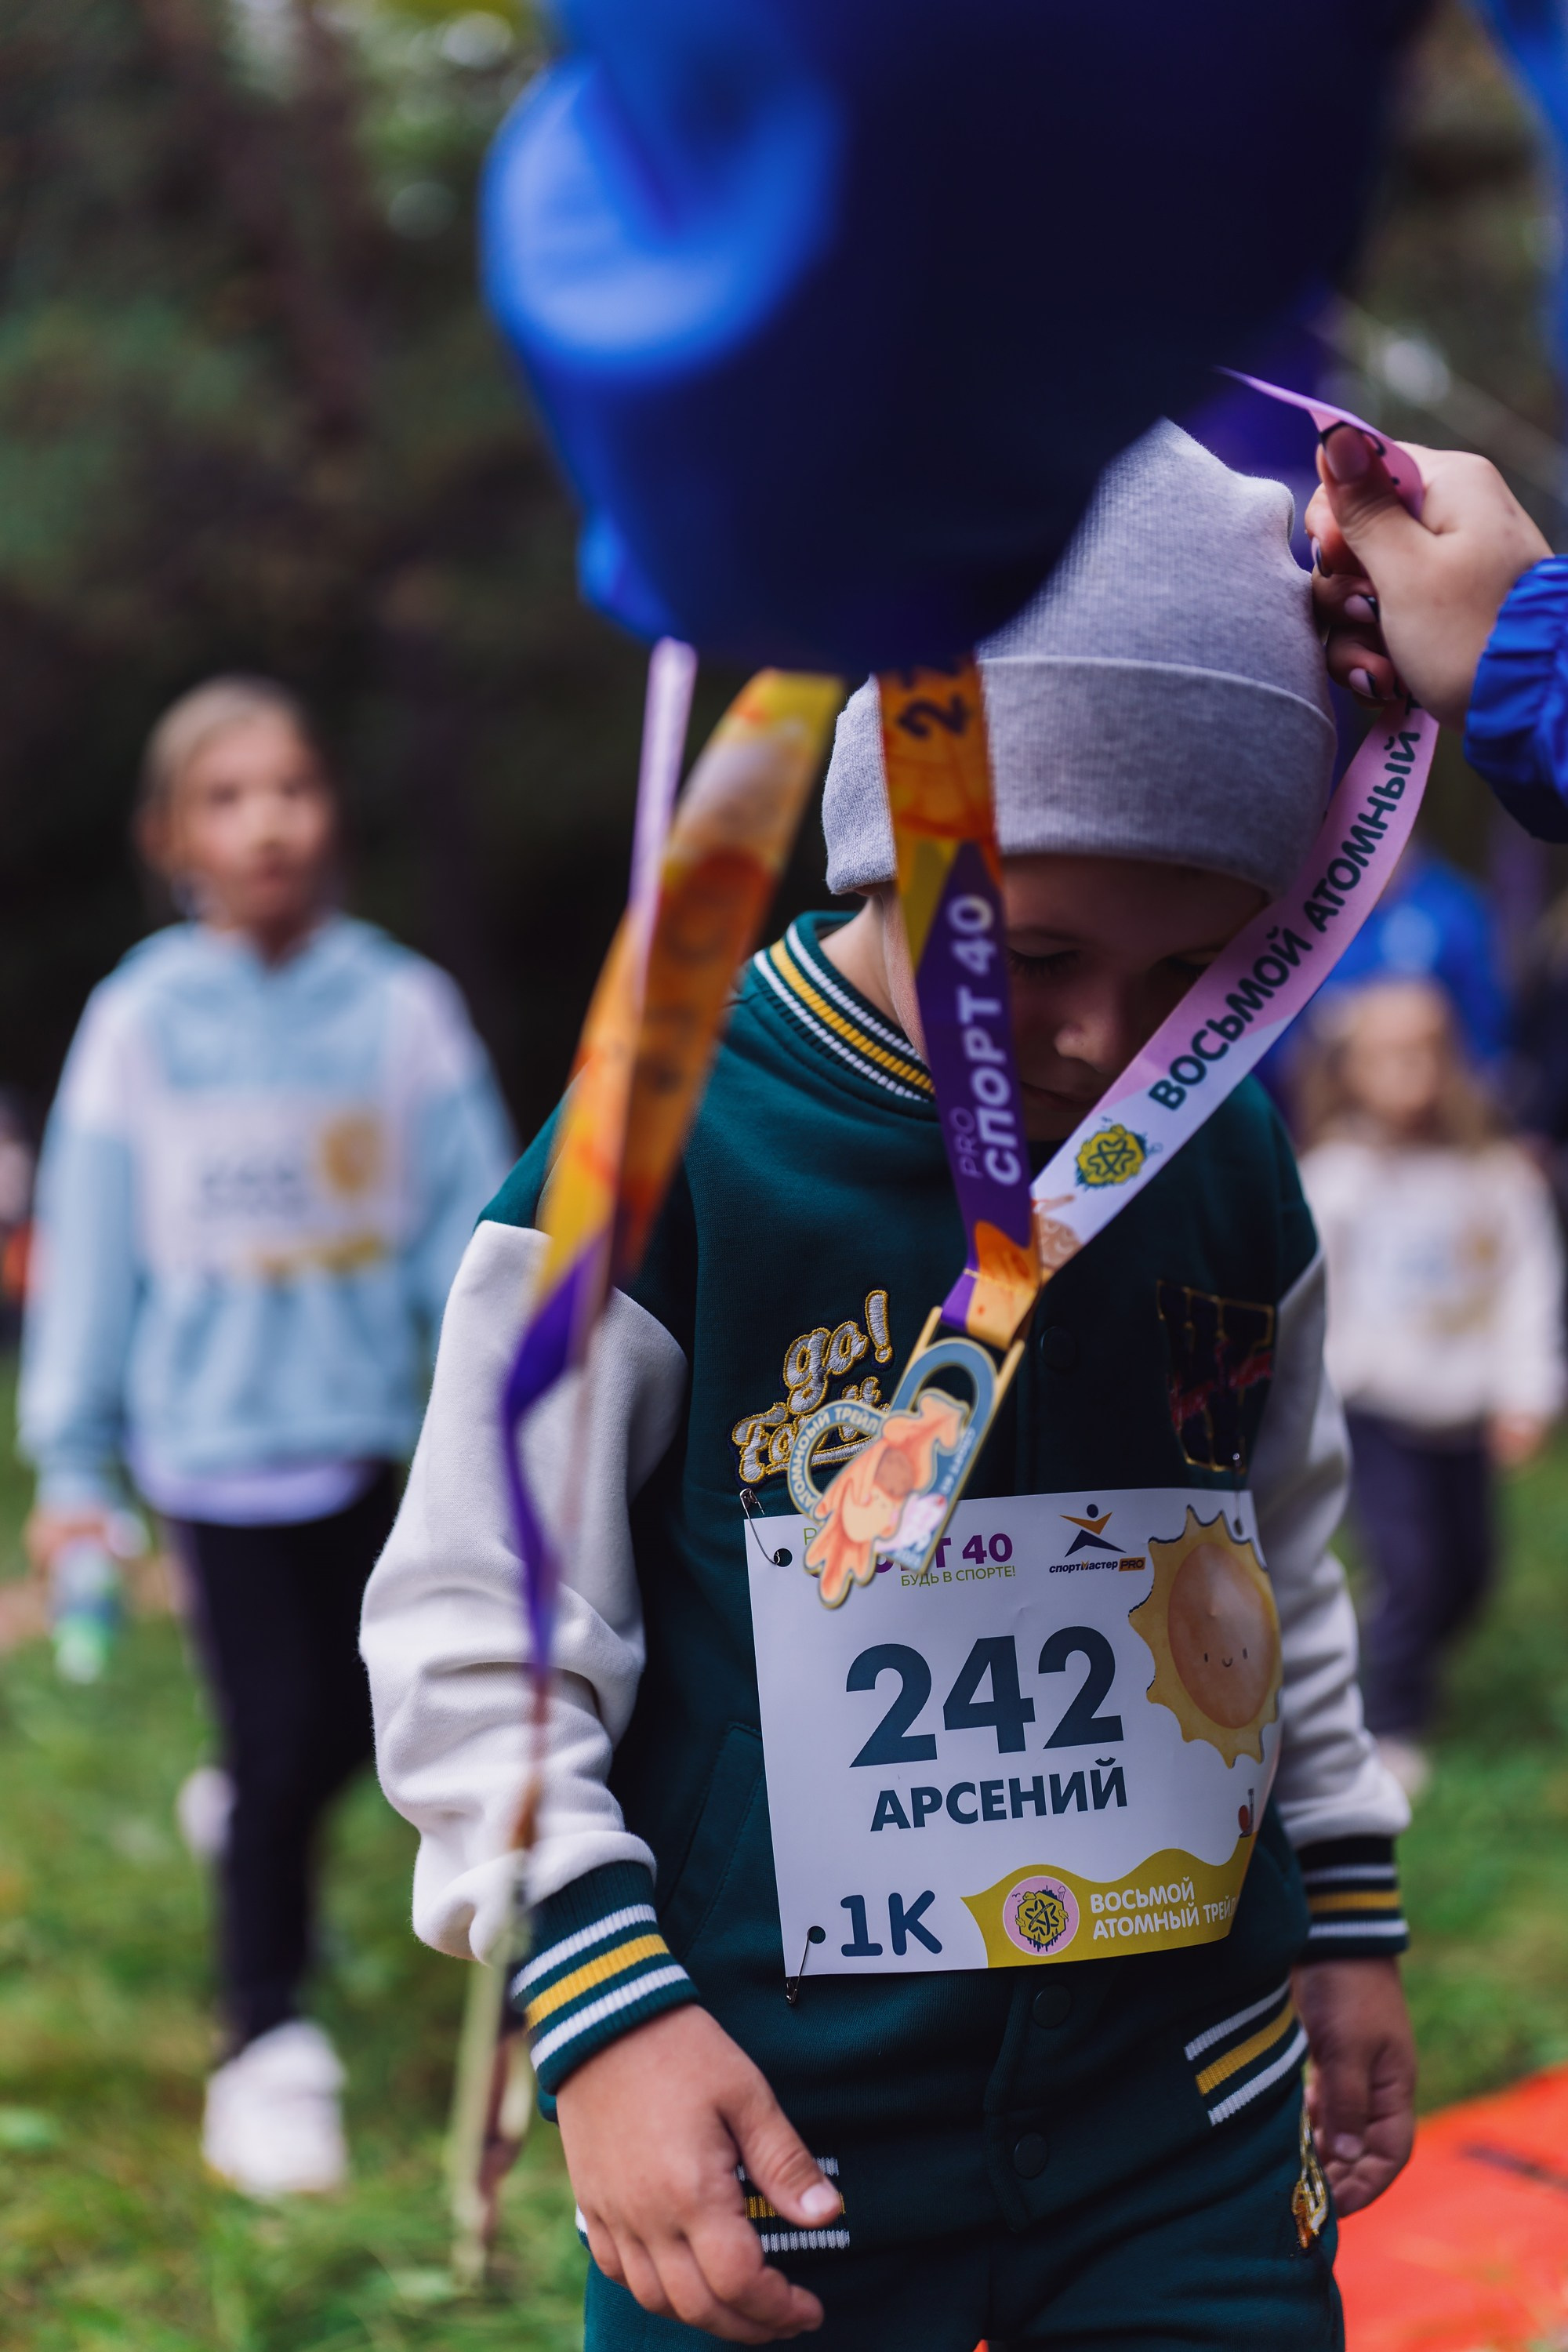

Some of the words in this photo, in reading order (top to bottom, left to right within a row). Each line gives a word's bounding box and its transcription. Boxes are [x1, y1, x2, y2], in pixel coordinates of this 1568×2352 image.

[947, 895, 996, 977] 40
[1148, 927, 1312, 1110] ВОСЬМОЙ
[1303, 731, 1421, 933] АТОМНЫЙ
[956, 985, 1022, 1187] СПОРТ
[782, 1289, 893, 1416] go!
[901, 1571, 940, 1588] БУДЬ
[942, 1570, 953, 1584] В
[955, 1565, 1017, 1582] СПОРТЕ!
[961, 1533, 1014, 1566] 40
[1120, 1559, 1145, 1570] PRO
[846, 1625, 1124, 1769] 242
[870, 1756, 1127, 1832] АРСЕНИЙ
[1090, 1876, 1195, 1915] ВОСЬМОЙ
[1093, 1901, 1200, 1941] АТОМНЫЙ
